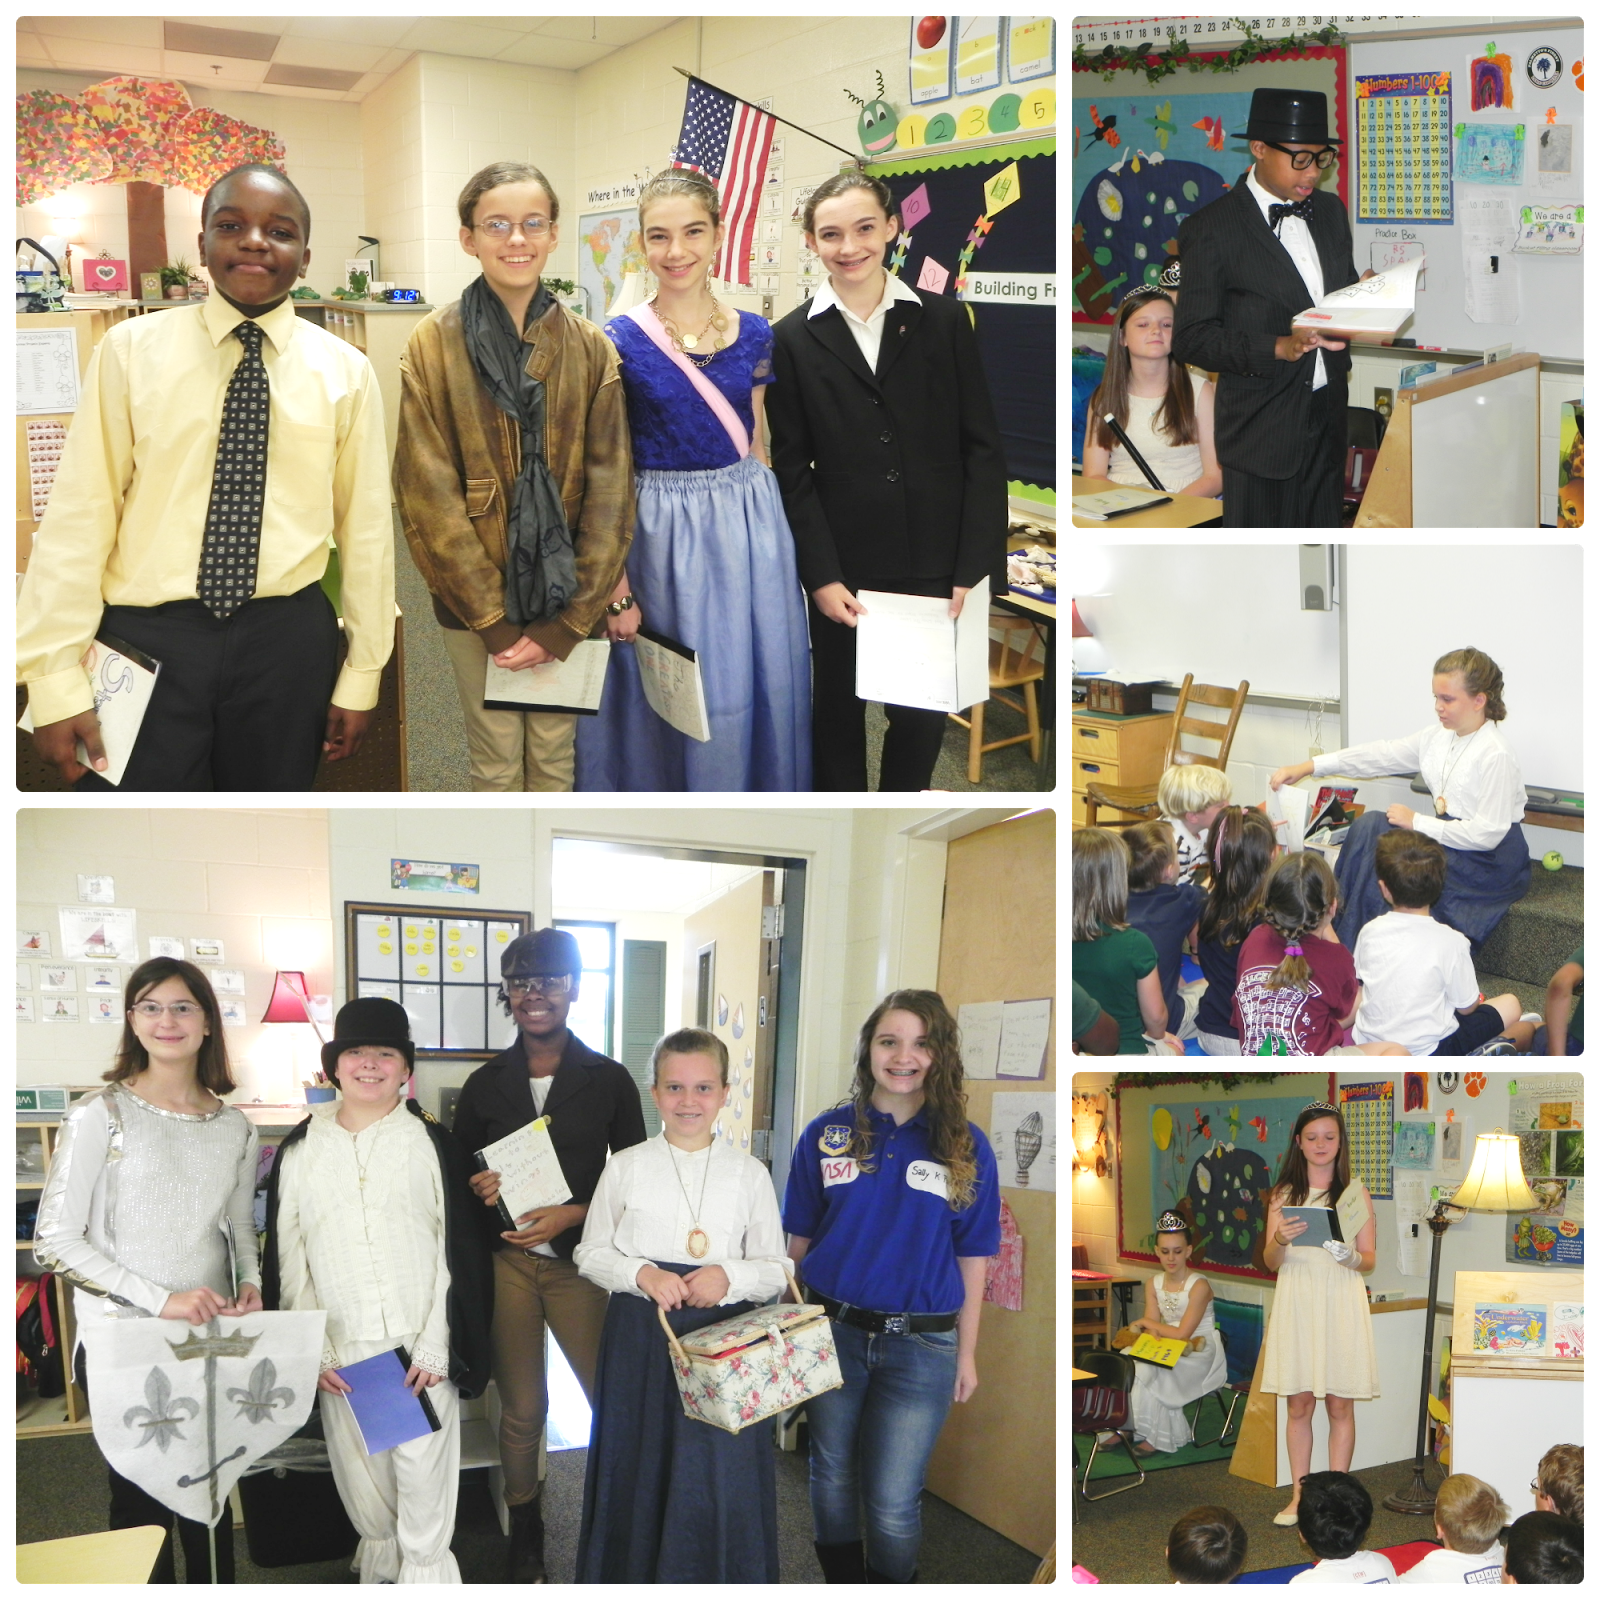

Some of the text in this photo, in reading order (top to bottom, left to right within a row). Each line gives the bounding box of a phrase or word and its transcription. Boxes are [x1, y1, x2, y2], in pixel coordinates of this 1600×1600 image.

[1075, 34, 1083, 43] 13
[1088, 33, 1095, 42] 14
[1100, 32, 1107, 41] 15
[1113, 31, 1120, 40] 16
[1126, 30, 1133, 39] 17
[1139, 29, 1146, 38] 18
[1153, 27, 1161, 36] 19
[1166, 26, 1174, 36] 20
[1180, 24, 1187, 34] 21
[1194, 23, 1201, 33] 22
[1208, 22, 1216, 32] 23
[1222, 21, 1230, 31] 24
[1238, 20, 1246, 30] 25
[1252, 19, 1260, 29] 26
[1267, 18, 1275, 28] 27
[1282, 17, 1290, 27] 28
[1297, 16, 1306, 26] 29
[1312, 16, 1322, 25] 30
[1020, 60, 1041, 73] camel
[970, 74, 983, 85] bat
[921, 87, 938, 100] apple
[933, 120, 948, 140] 2
[968, 108, 984, 136] 3
[1000, 105, 1009, 118] 4
[1034, 102, 1045, 119] 5
[588, 185, 635, 203] Where in the
[906, 199, 920, 214] 10
[1535, 212, 1548, 220] We
[1375, 228, 1417, 240] Practice Box
[923, 268, 941, 289] 12
[393, 290, 416, 301] 9:12
[974, 281, 1037, 300] Building
[1518, 1081, 1535, 1090] How
[1547, 1080, 1565, 1090] Frog
[1569, 1079, 1583, 1087] For
[912, 1165, 930, 1181] Sally
[935, 1172, 940, 1180] K
